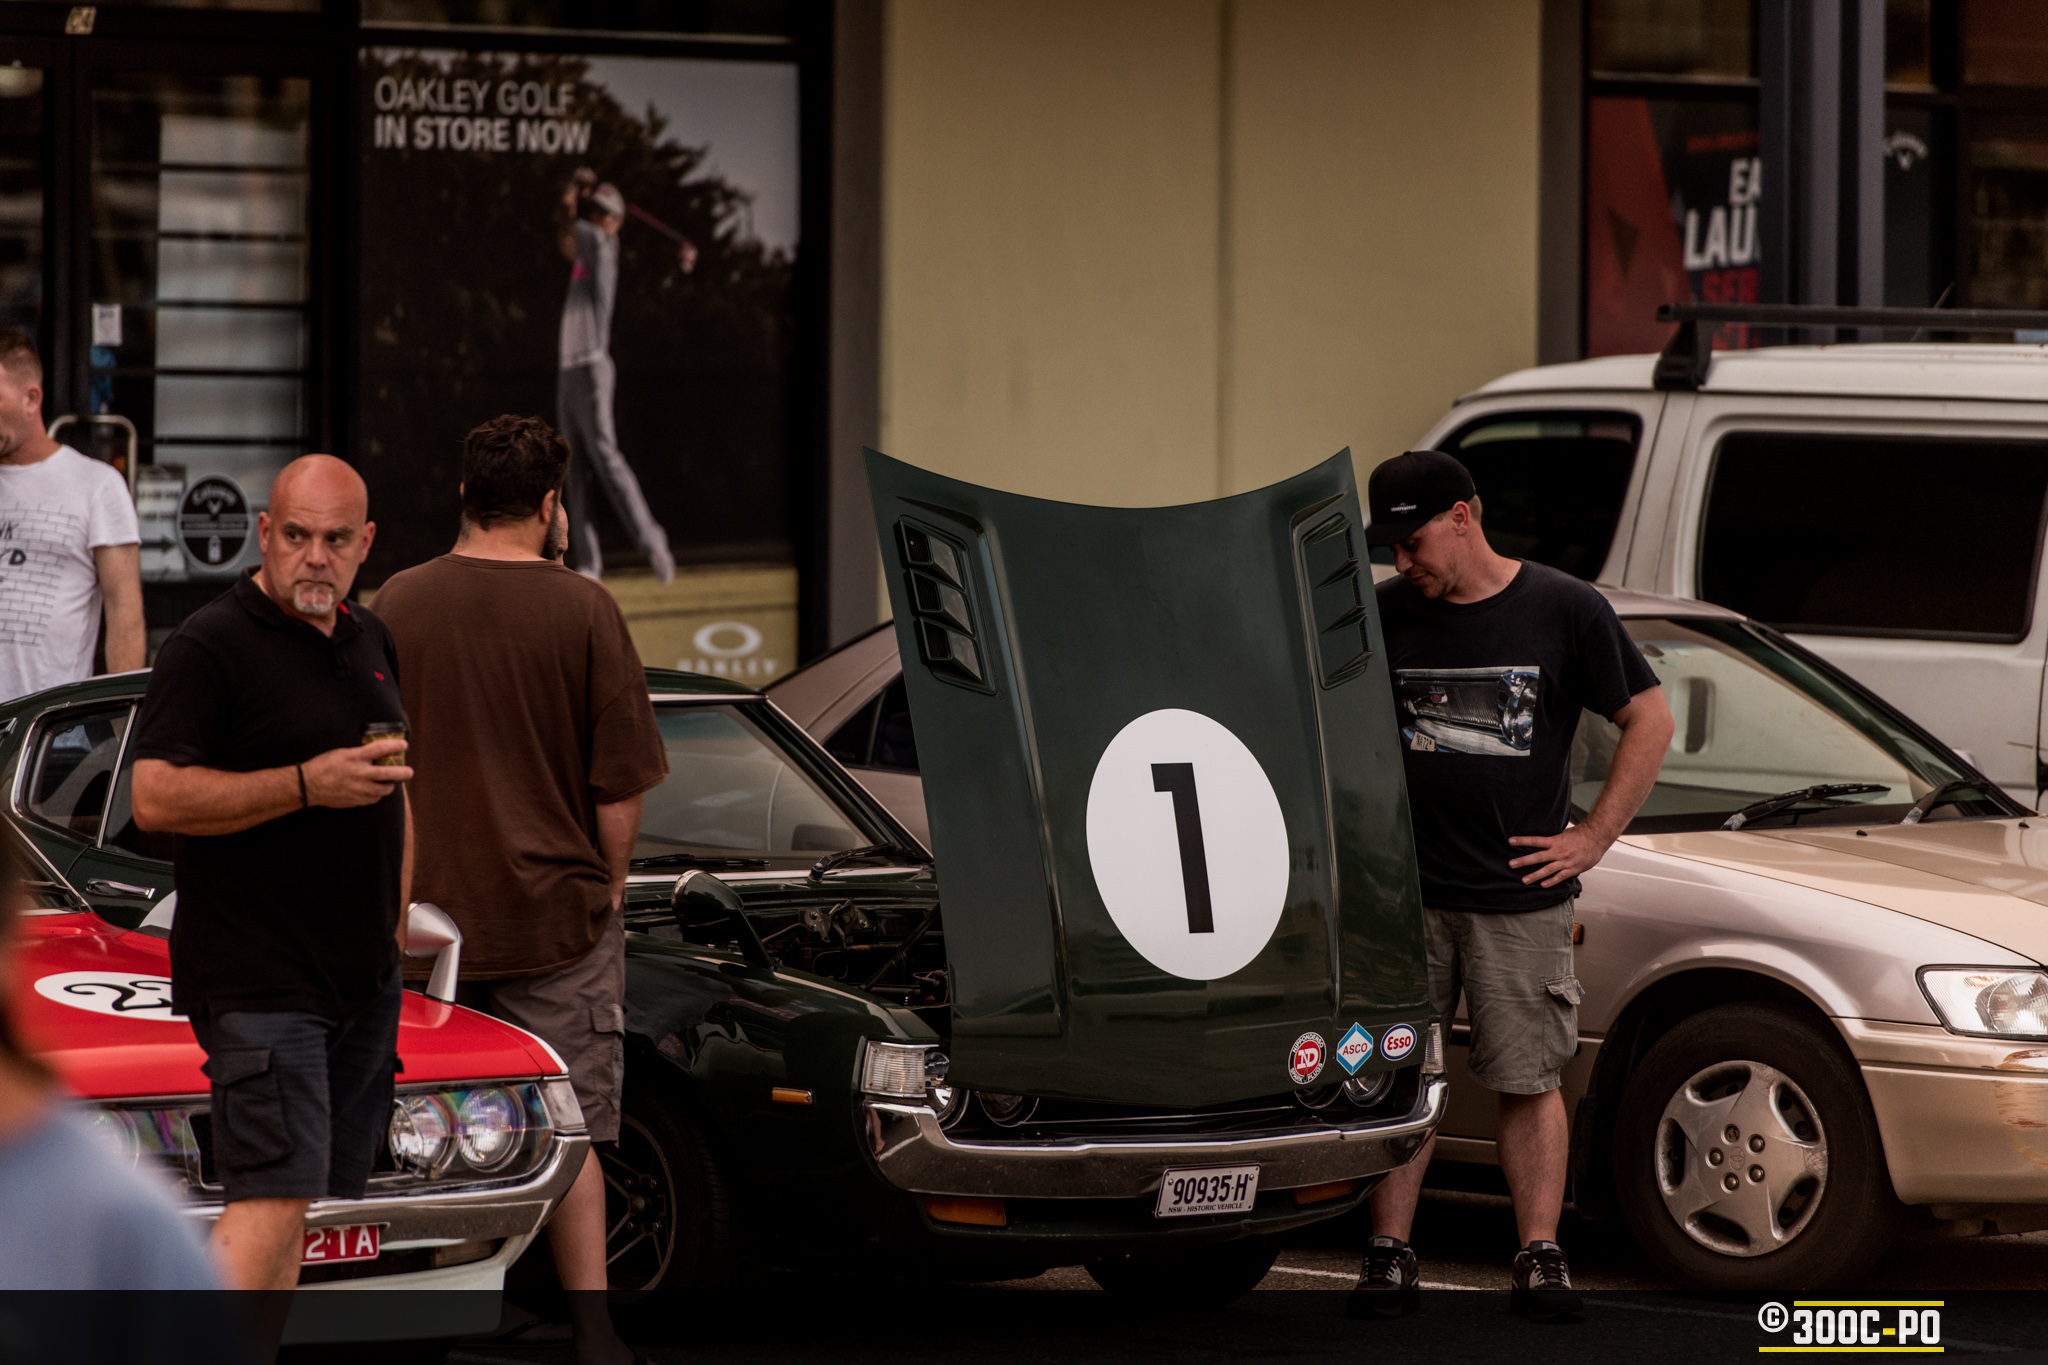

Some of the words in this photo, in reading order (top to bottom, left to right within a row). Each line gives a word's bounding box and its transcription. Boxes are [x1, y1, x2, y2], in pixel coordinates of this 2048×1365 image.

[374, 76, 490, 113] OAKLEY
[496, 80, 574, 116] GOLF
[374, 115, 407, 148] IN
[413, 116, 511, 152] STORE
[517, 119, 592, 155] NOW
[1684, 206, 1762, 271] LAU
[1151, 762, 1215, 934] 1
[1296, 1047, 1319, 1070] ND
[1342, 1042, 1368, 1056] ASCO
[1187, 1204, 1216, 1212] HISTORIC
[1217, 1202, 1243, 1210] VEHICLE
